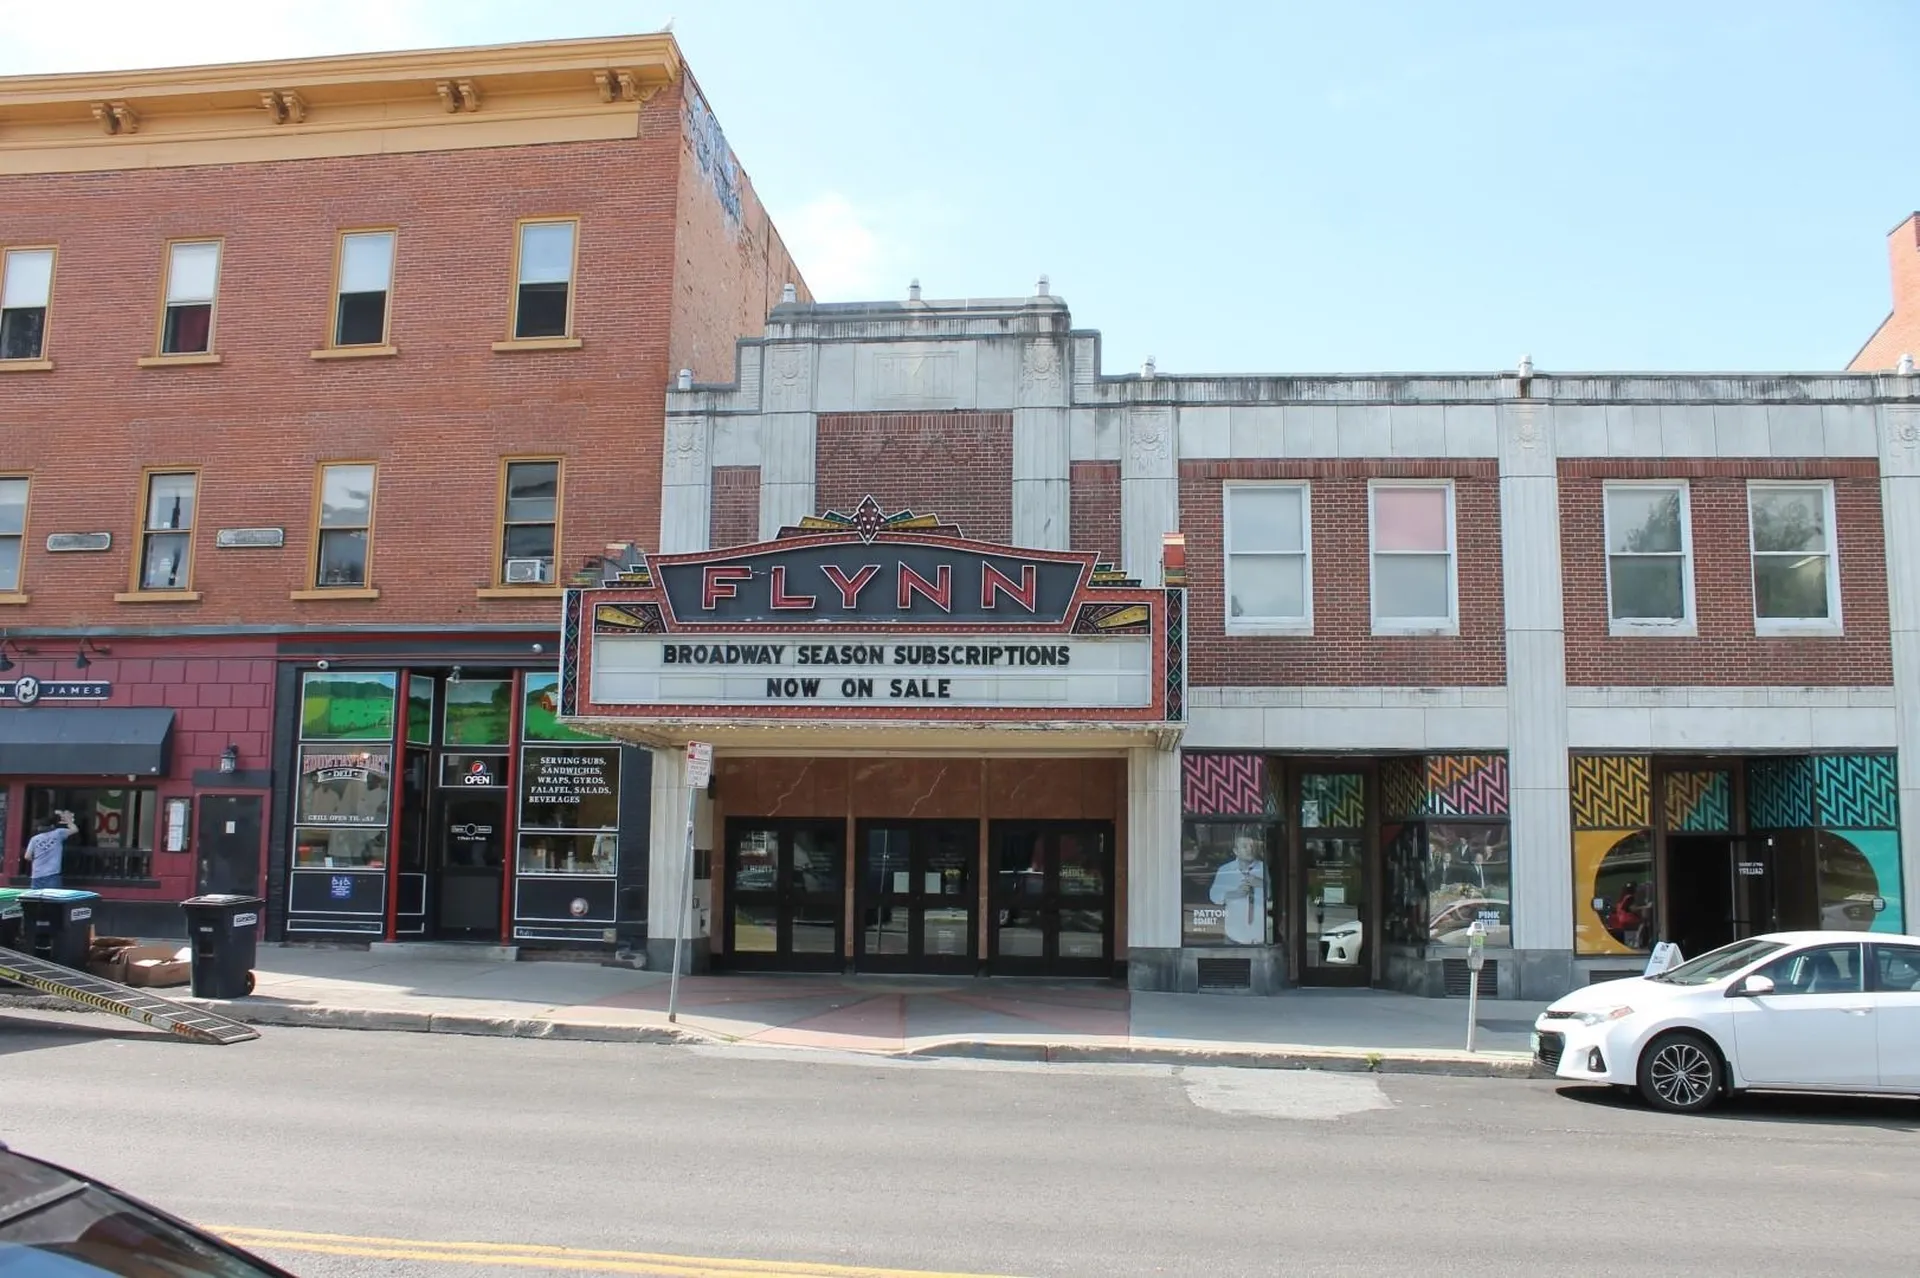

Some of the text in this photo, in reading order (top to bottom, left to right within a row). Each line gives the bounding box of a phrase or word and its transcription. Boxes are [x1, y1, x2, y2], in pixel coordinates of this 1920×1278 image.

[701, 560, 1036, 613] FLYNN
[663, 645, 1070, 666] BROADWAY SEASON SUBSCRIPTIONS
[48, 686, 102, 695] JAMES
[766, 678, 951, 698] NOW ON SALE
[540, 757, 607, 766] SERVING SUBS,
[464, 775, 490, 784] OPEN
[573, 777, 606, 785] GYROS,
[573, 787, 612, 795] SALADS,
[529, 796, 580, 804] BEVERAGES
[1478, 910, 1500, 919] PINK
